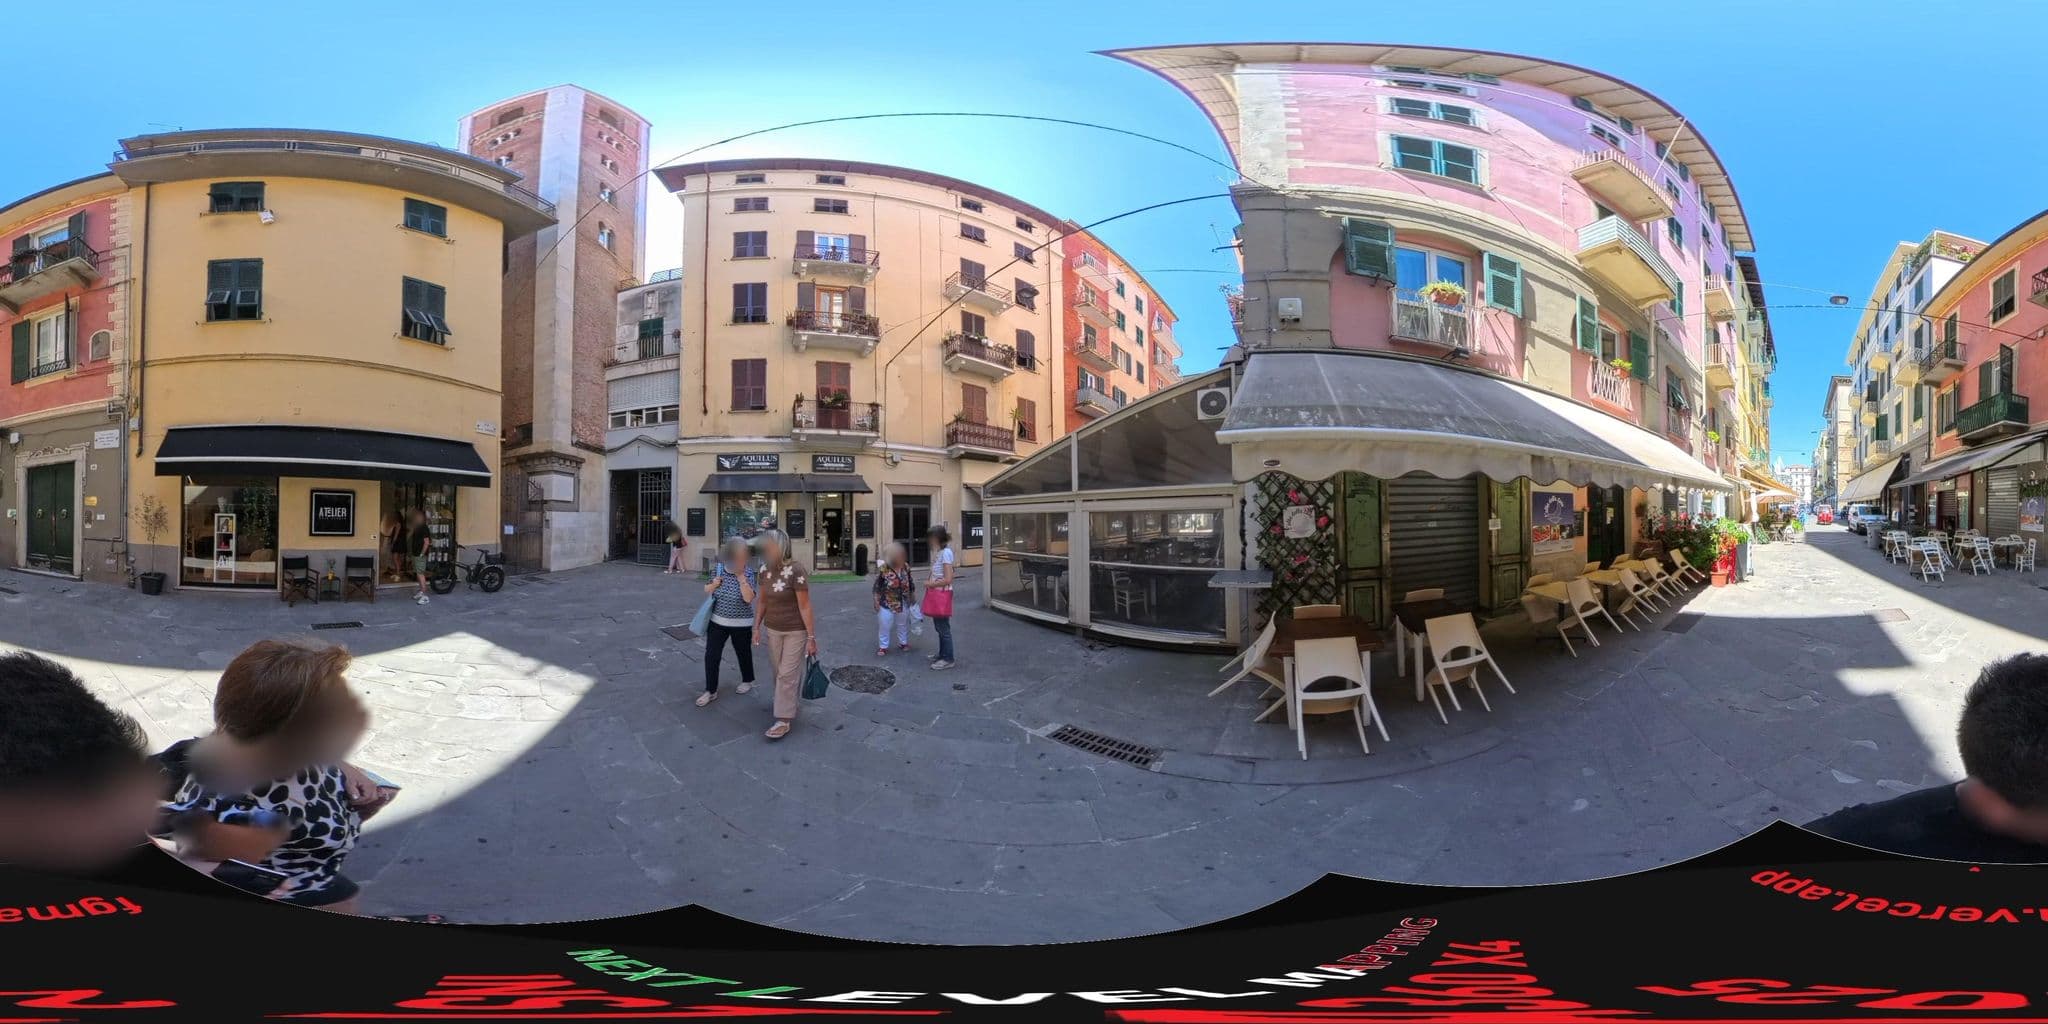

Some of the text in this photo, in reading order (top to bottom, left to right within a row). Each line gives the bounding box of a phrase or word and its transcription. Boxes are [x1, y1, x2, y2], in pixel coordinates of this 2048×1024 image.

[741, 455, 778, 463] AQUILUS
[816, 456, 853, 464] AQUILUS
[319, 507, 347, 518] ATELIER
